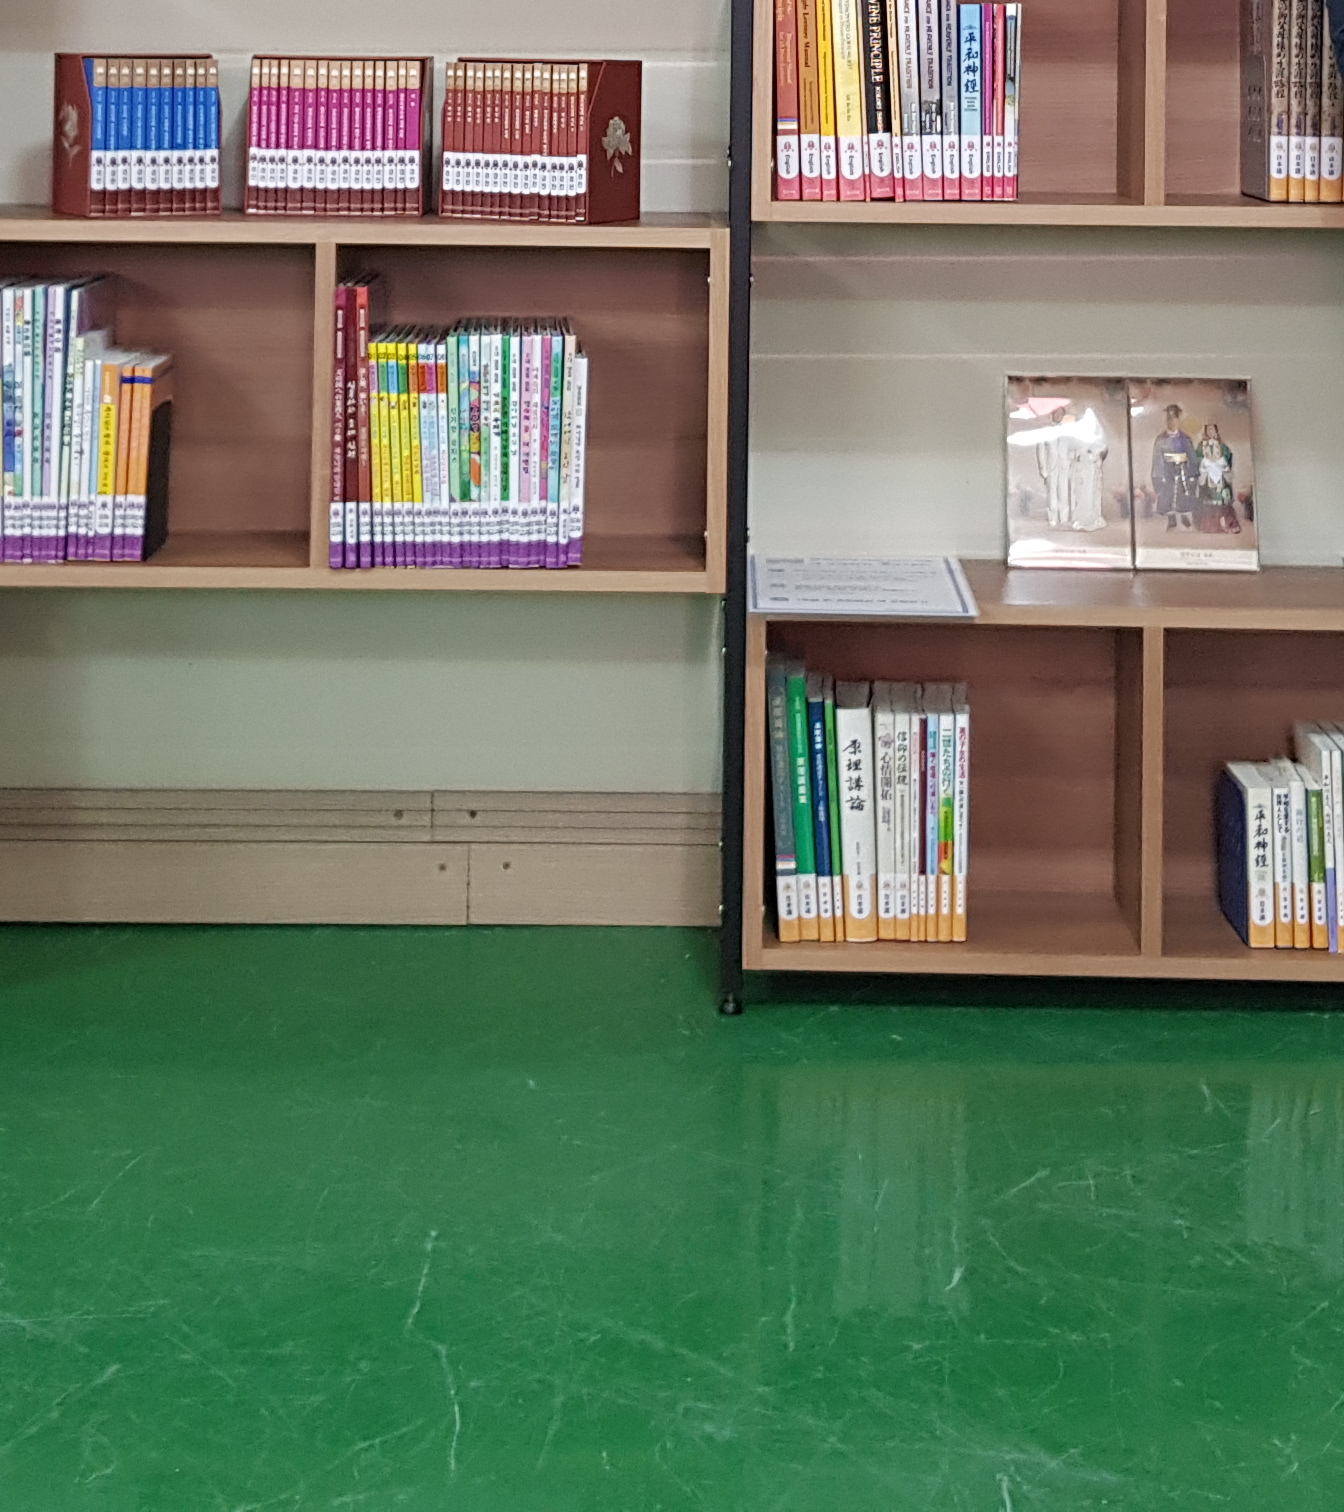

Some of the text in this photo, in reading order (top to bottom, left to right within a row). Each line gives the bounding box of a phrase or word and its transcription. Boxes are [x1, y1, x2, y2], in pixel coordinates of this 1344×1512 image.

[869, 26, 883, 83] PRINCIPLE
[963, 32, 979, 94] 平和神經
[842, 738, 866, 811] 原理講論
[1254, 809, 1269, 868] 平和神經
